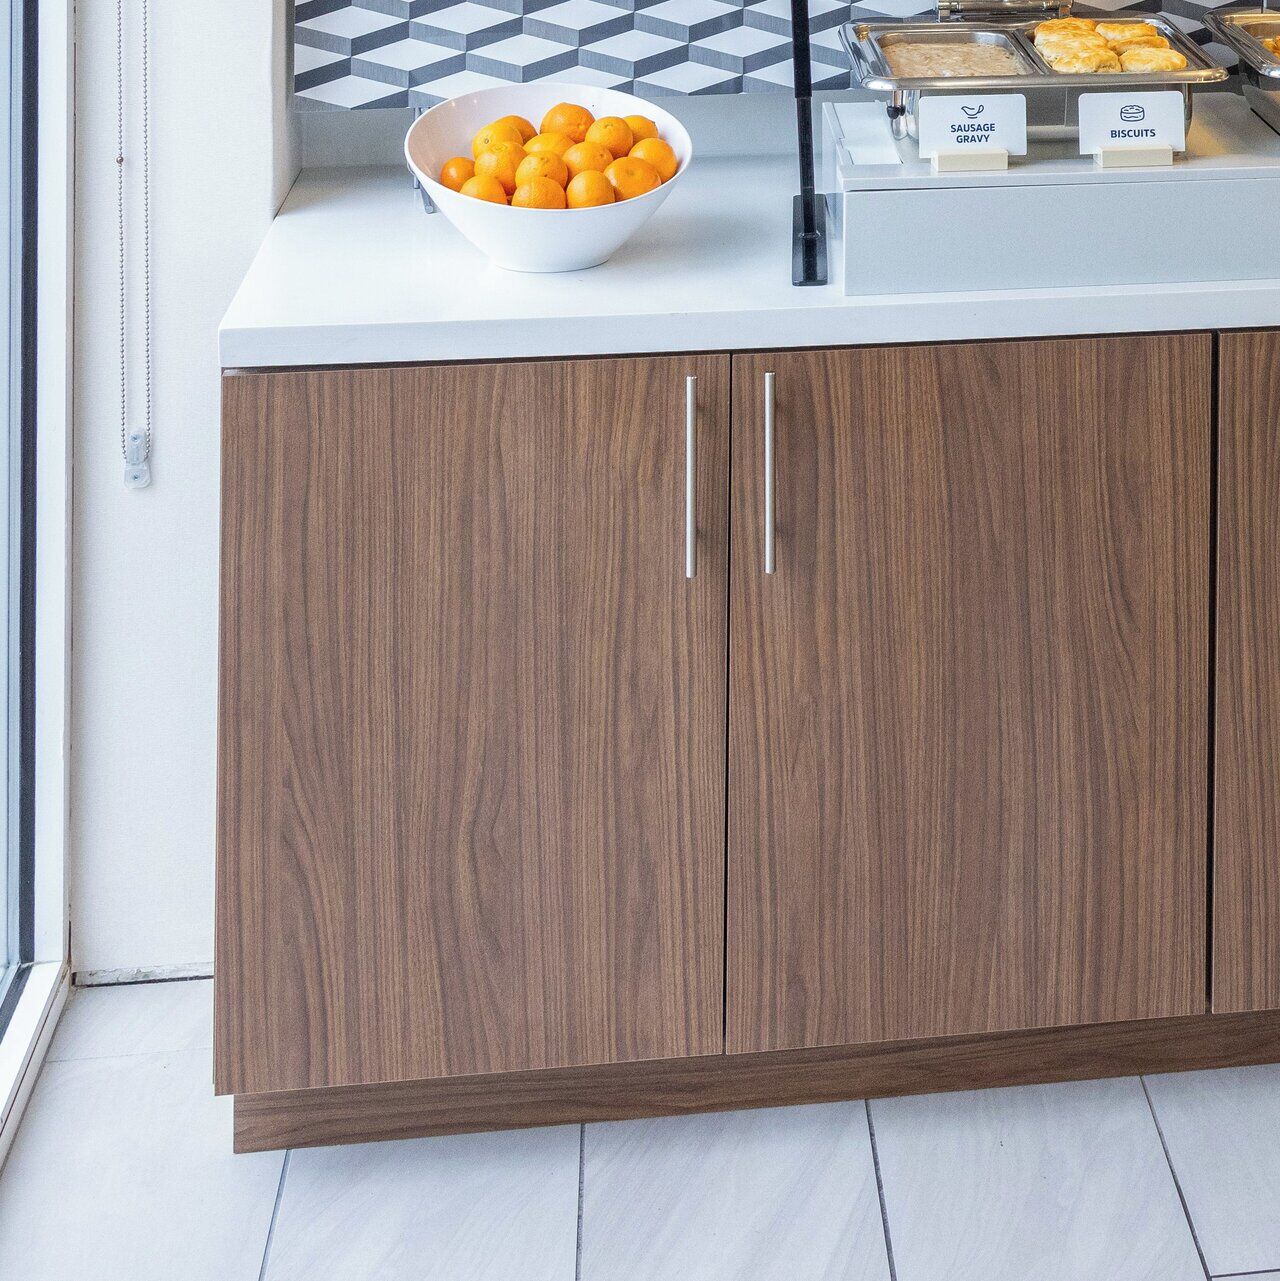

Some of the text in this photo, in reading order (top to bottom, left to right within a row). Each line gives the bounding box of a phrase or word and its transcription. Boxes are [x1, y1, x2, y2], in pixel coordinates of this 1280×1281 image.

[950, 122, 996, 133] SAUSAGE
[955, 134, 990, 144] GRAVY
[1110, 128, 1156, 139] BISCUITS
